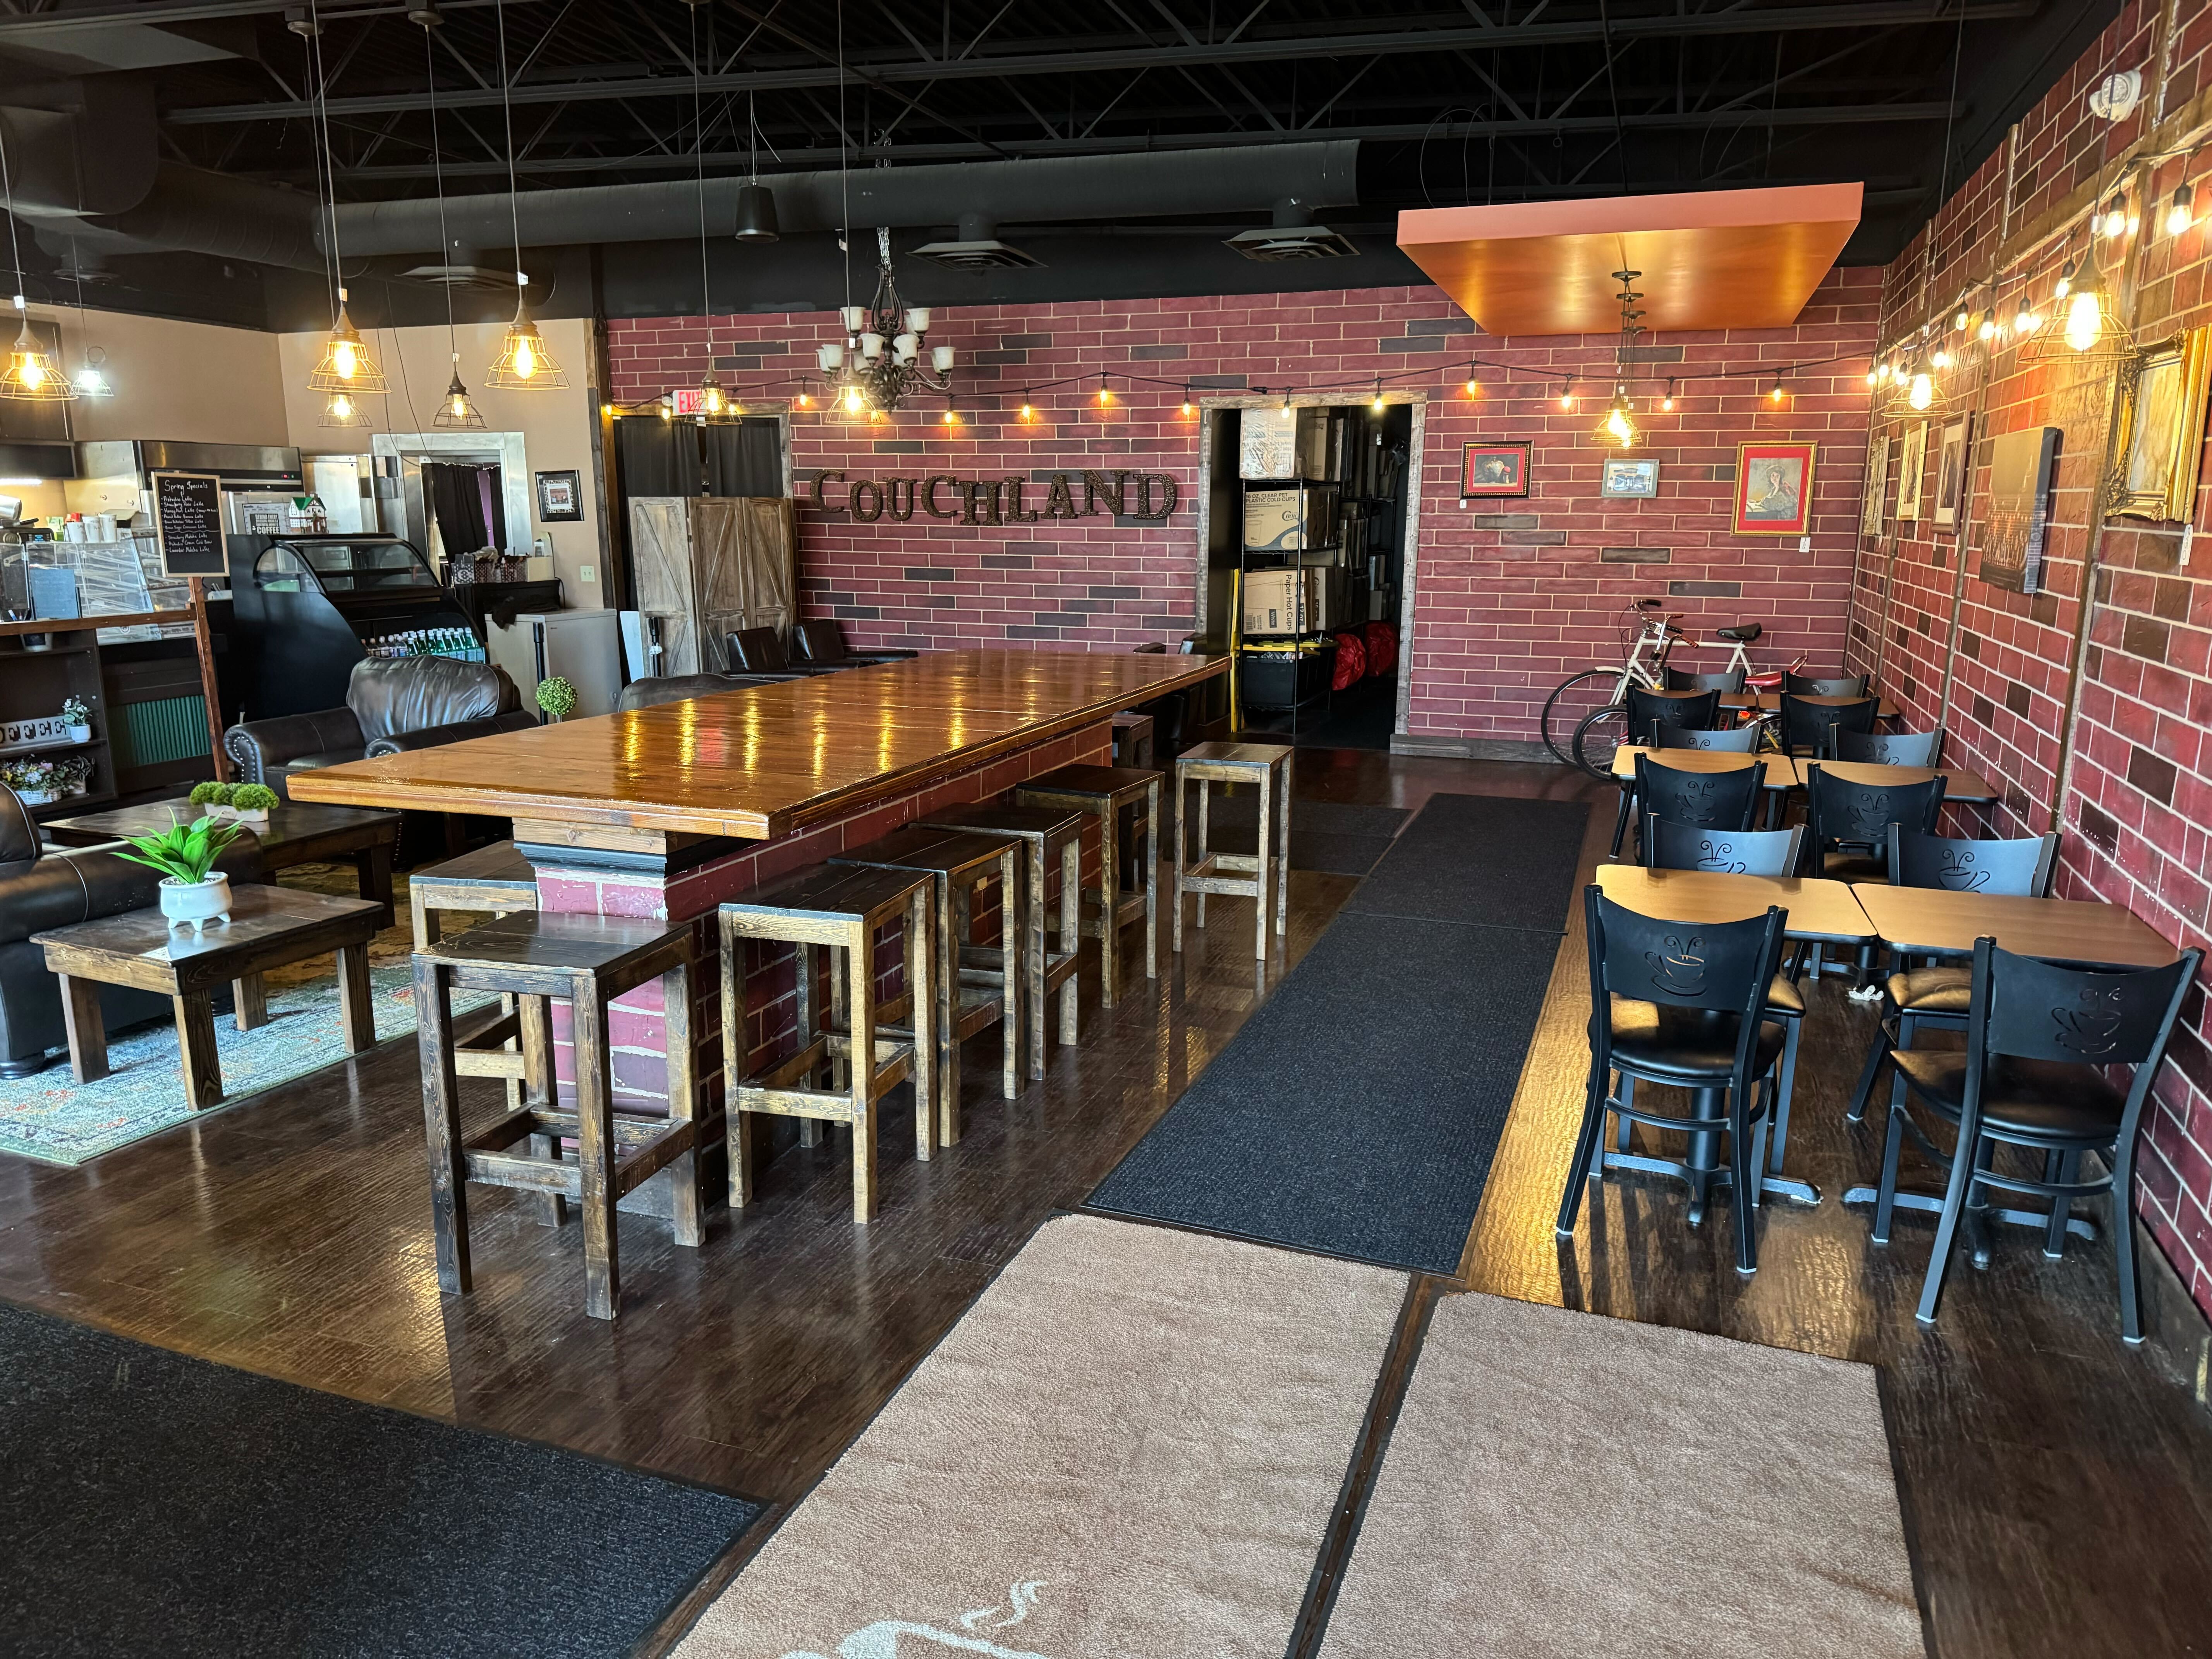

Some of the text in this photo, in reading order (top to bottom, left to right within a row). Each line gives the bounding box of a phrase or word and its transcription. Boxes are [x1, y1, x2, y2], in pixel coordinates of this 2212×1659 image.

[678, 391, 702, 413] EXIT
[164, 479, 208, 495] Spring Specials
[809, 469, 1177, 526] COUCHLAND
[256, 526, 280, 534] COFFEE
